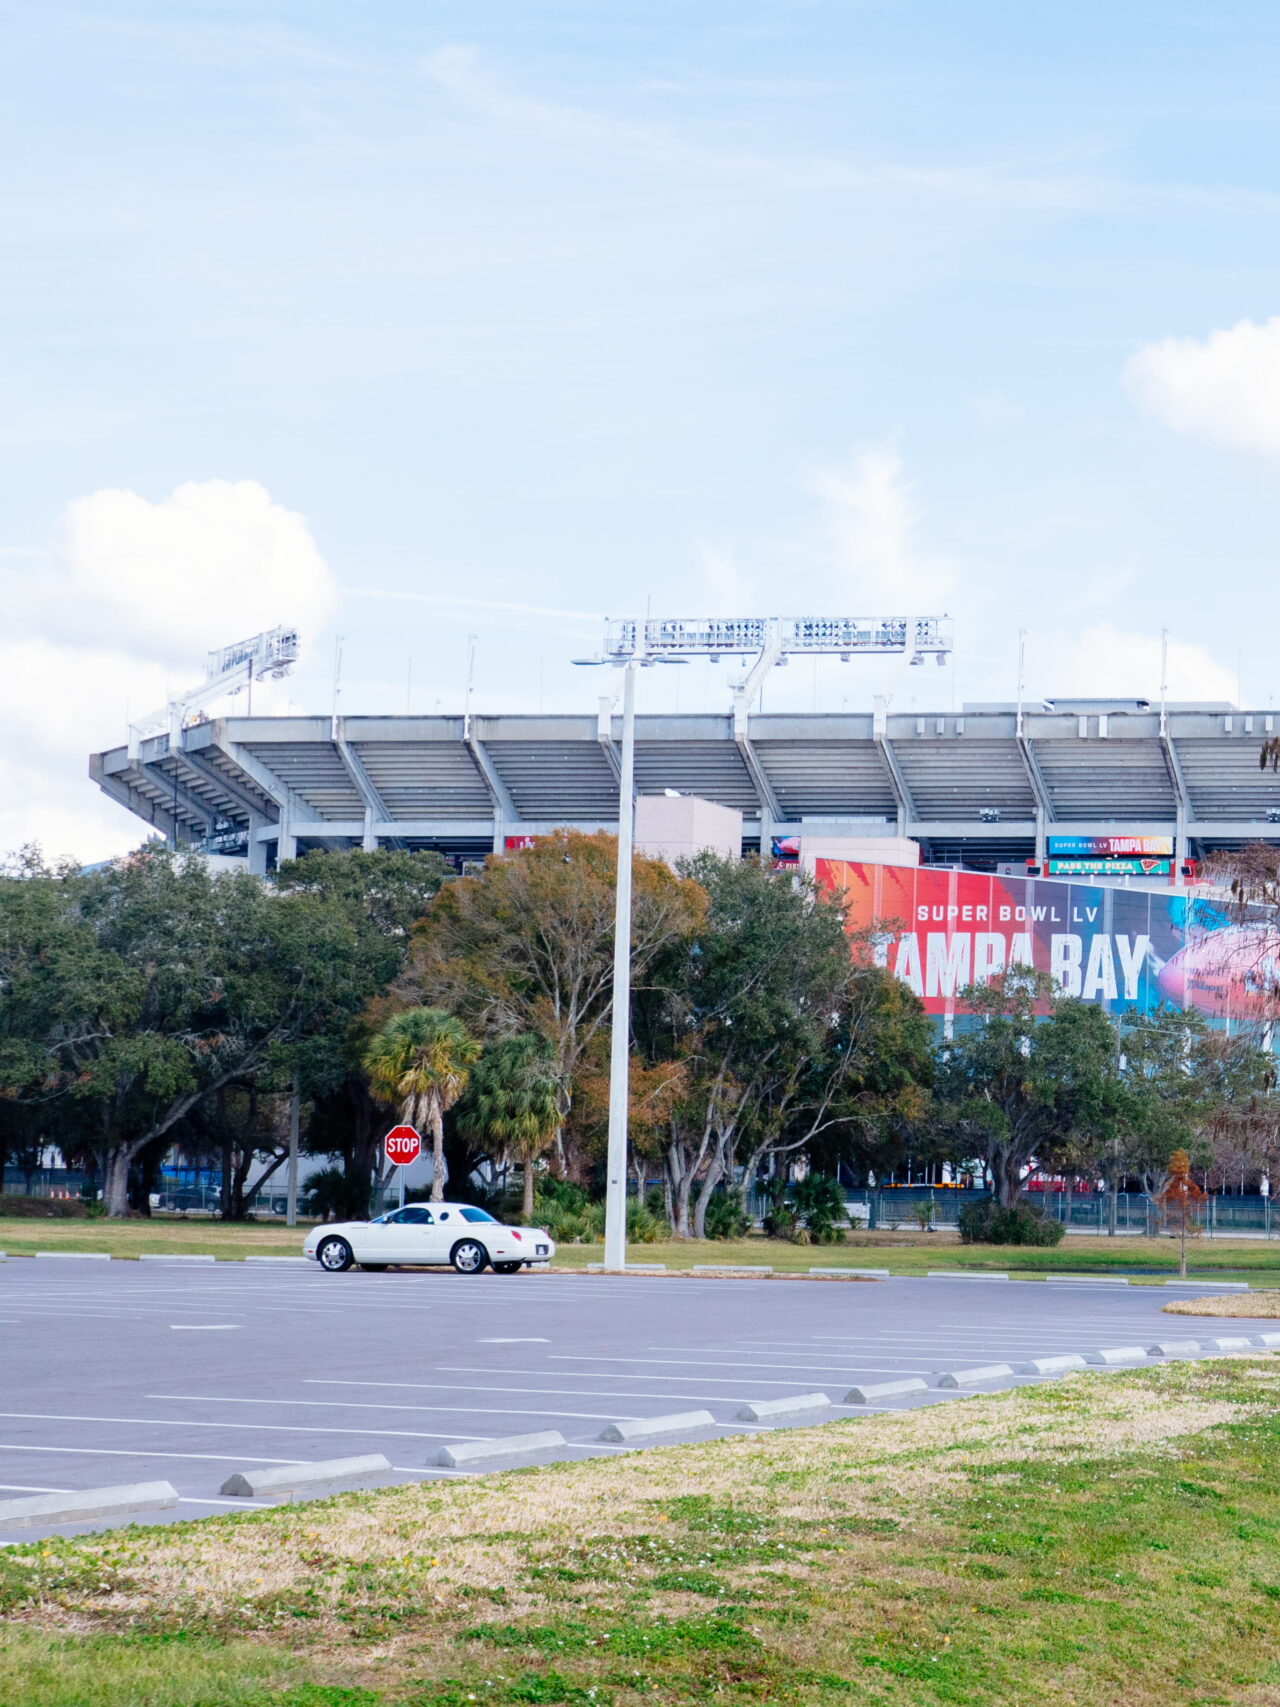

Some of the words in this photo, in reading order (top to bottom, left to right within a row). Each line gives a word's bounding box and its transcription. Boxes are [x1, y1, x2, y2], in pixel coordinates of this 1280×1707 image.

[1108, 839, 1141, 852] TAMPA
[1057, 862, 1082, 870] PASS
[1084, 862, 1103, 870] THE
[1105, 862, 1133, 870] PIZZA
[917, 905, 988, 921] SUPER
[999, 906, 1061, 922] BOWL
[1072, 906, 1098, 922] LV
[869, 932, 1037, 998] TAMPA
[1050, 934, 1151, 1000] BAY
[387, 1138, 419, 1153] STOP
